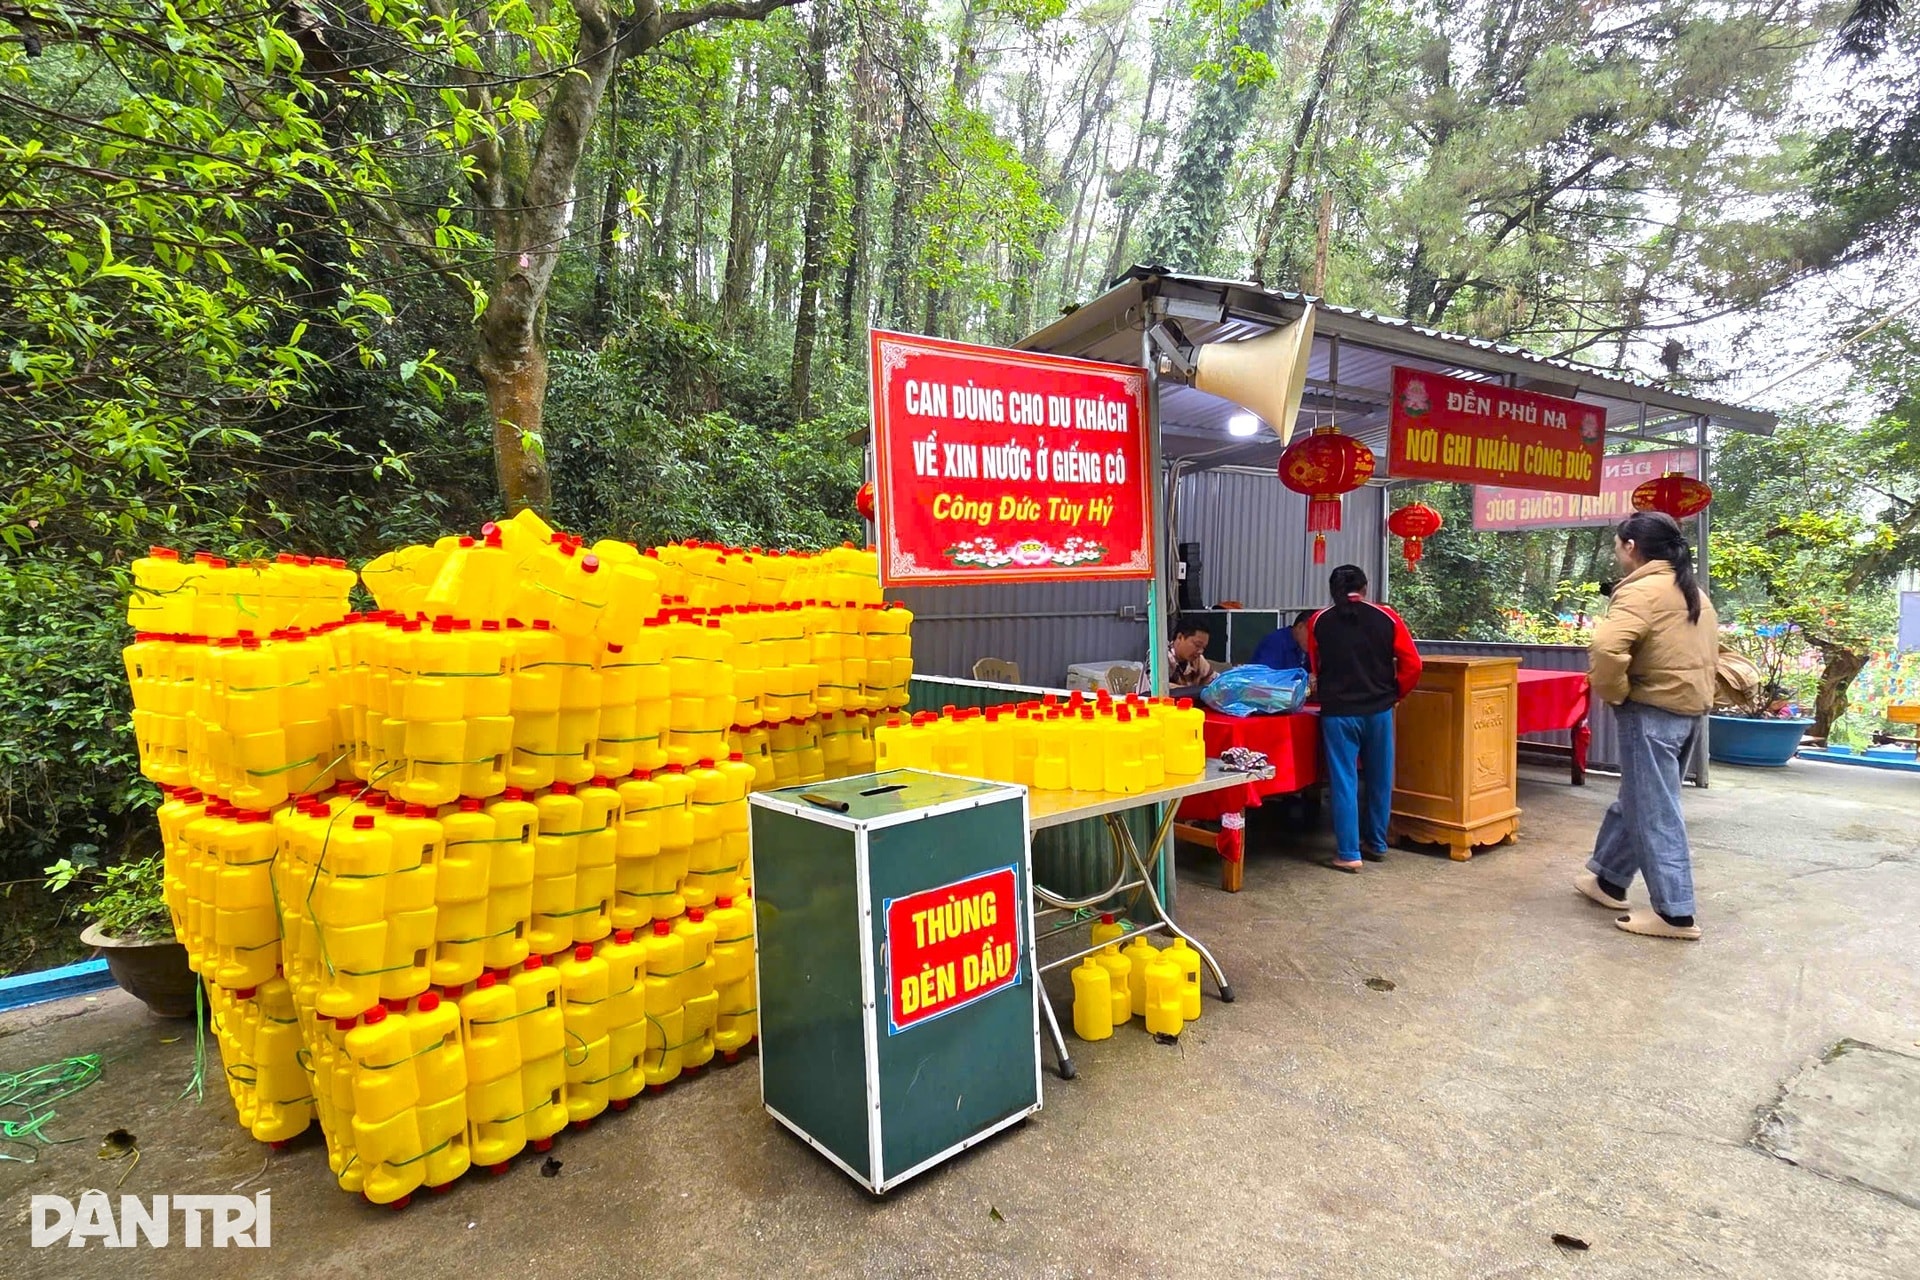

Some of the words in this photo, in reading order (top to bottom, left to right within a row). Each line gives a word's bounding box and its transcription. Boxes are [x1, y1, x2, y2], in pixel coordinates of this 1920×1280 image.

[905, 379, 947, 417] CAN
[953, 380, 1004, 422] DÙNG
[1009, 391, 1044, 426] CHO
[1049, 395, 1071, 429] DU
[1075, 394, 1128, 433] KHÁCH
[1447, 388, 1491, 418] ĐỀN
[1498, 401, 1537, 424] PHỦ
[1543, 409, 1567, 430] NA
[913, 430, 938, 477] VỀ
[943, 443, 977, 478] XIN
[983, 438, 1031, 481] NƯỚC
[1036, 437, 1049, 482] Ở
[1052, 440, 1101, 483] GIẾNG
[1105, 450, 1126, 485] CÔ
[1406, 428, 1438, 463] NƠI
[1443, 433, 1472, 466] GHI
[1475, 434, 1521, 478] NHẬN
[1523, 440, 1563, 477] CÔNG
[1565, 444, 1593, 481] ĐỨC
[933, 493, 992, 526] Công
[999, 495, 1041, 520] Đức
[1048, 498, 1083, 527] Tùy
[1088, 496, 1114, 527] Hỷ
[912, 891, 997, 949] THÙNG
[901, 961, 956, 1015] ĐÈN
[963, 936, 1012, 993] DẦU
